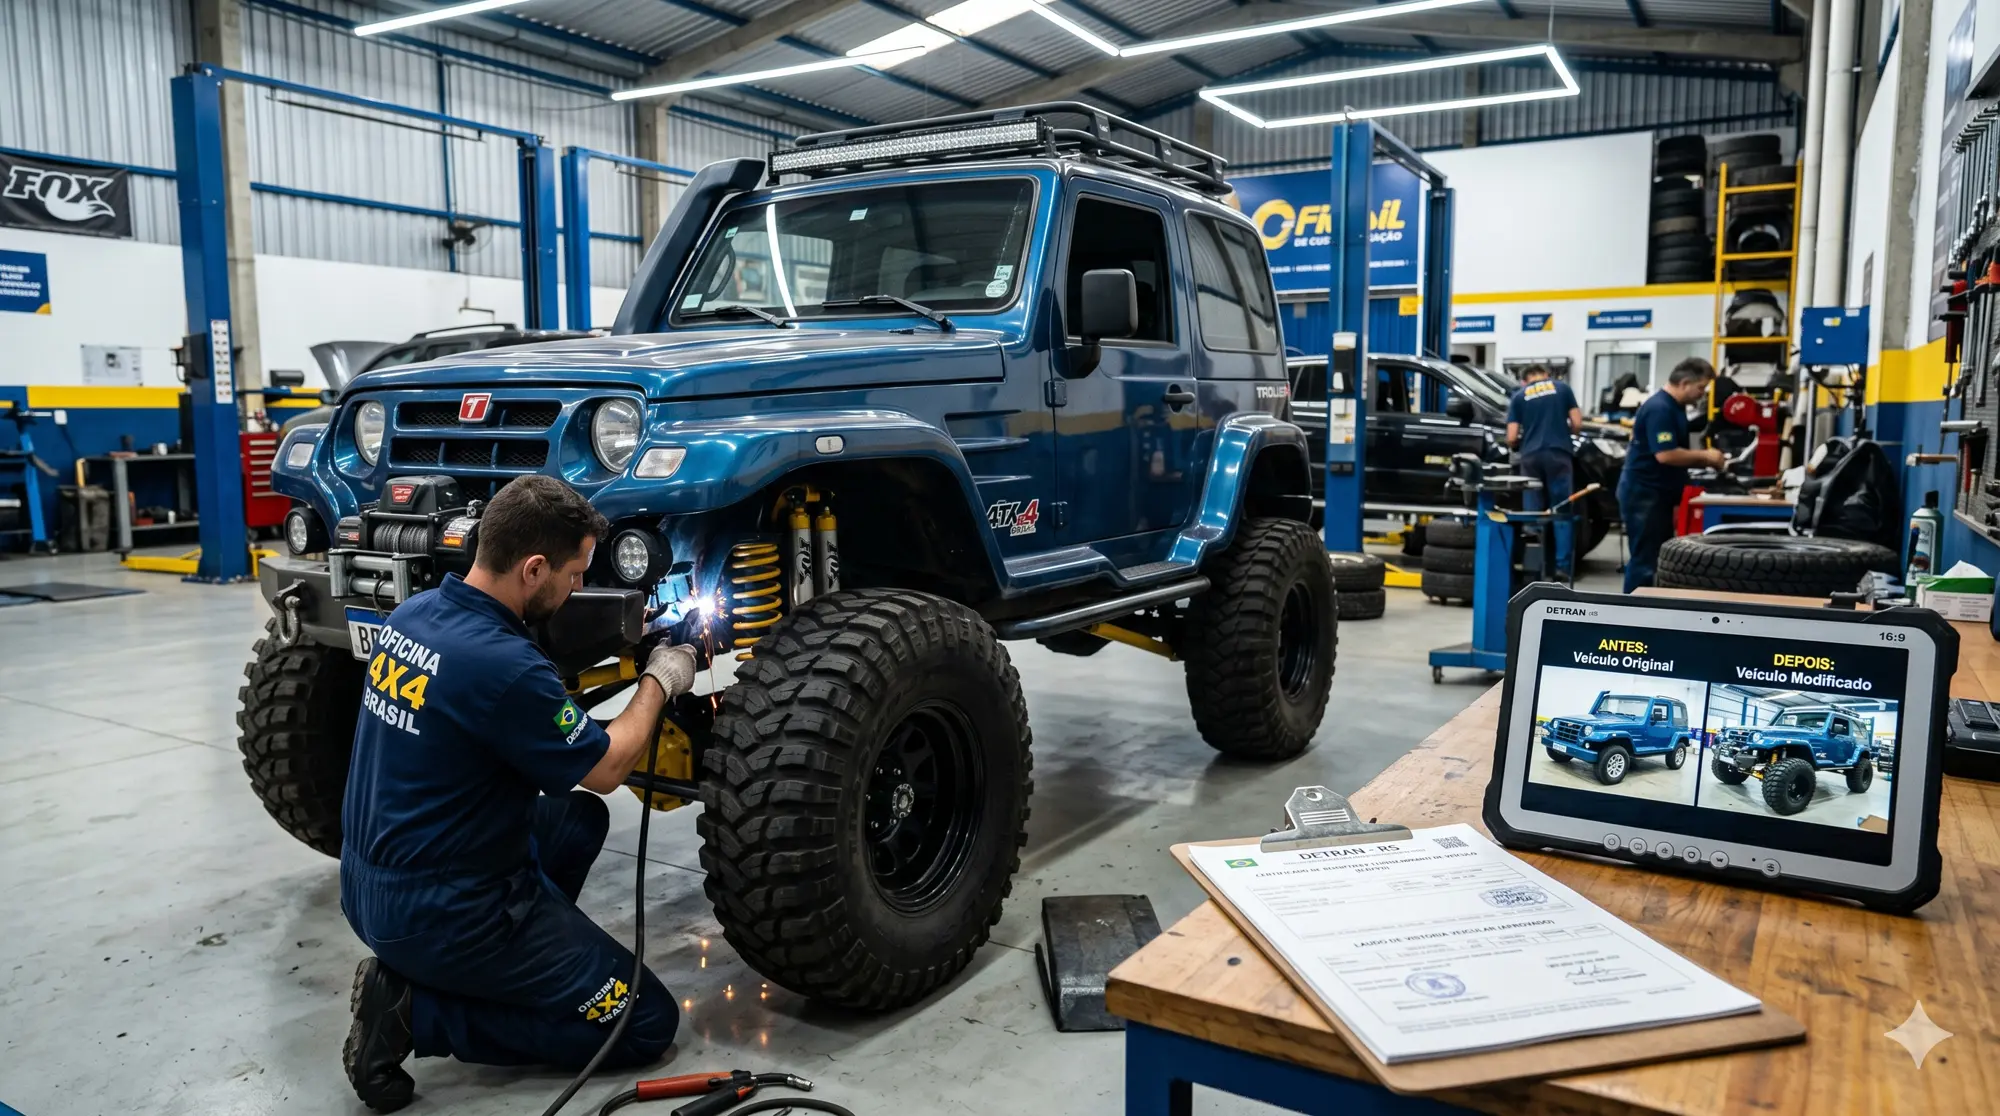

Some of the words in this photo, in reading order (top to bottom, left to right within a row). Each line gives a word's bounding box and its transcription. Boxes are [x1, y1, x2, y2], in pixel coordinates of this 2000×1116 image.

[2, 165, 115, 221] FOX
[1546, 606, 1586, 616] DETRAN
[1879, 632, 1906, 642] 16:9
[379, 625, 441, 676] OFICINA
[1598, 639, 1648, 654] ANTES:
[1622, 656, 1674, 672] Original
[1773, 653, 1835, 671] DEPOIS:
[369, 652, 429, 710] 4X4
[1736, 666, 1787, 683] Veículo
[1791, 672, 1872, 691] Modificado
[364, 686, 420, 735] BRASIL
[1298, 848, 1366, 860] DETRAN
[1377, 844, 1400, 852] RS
